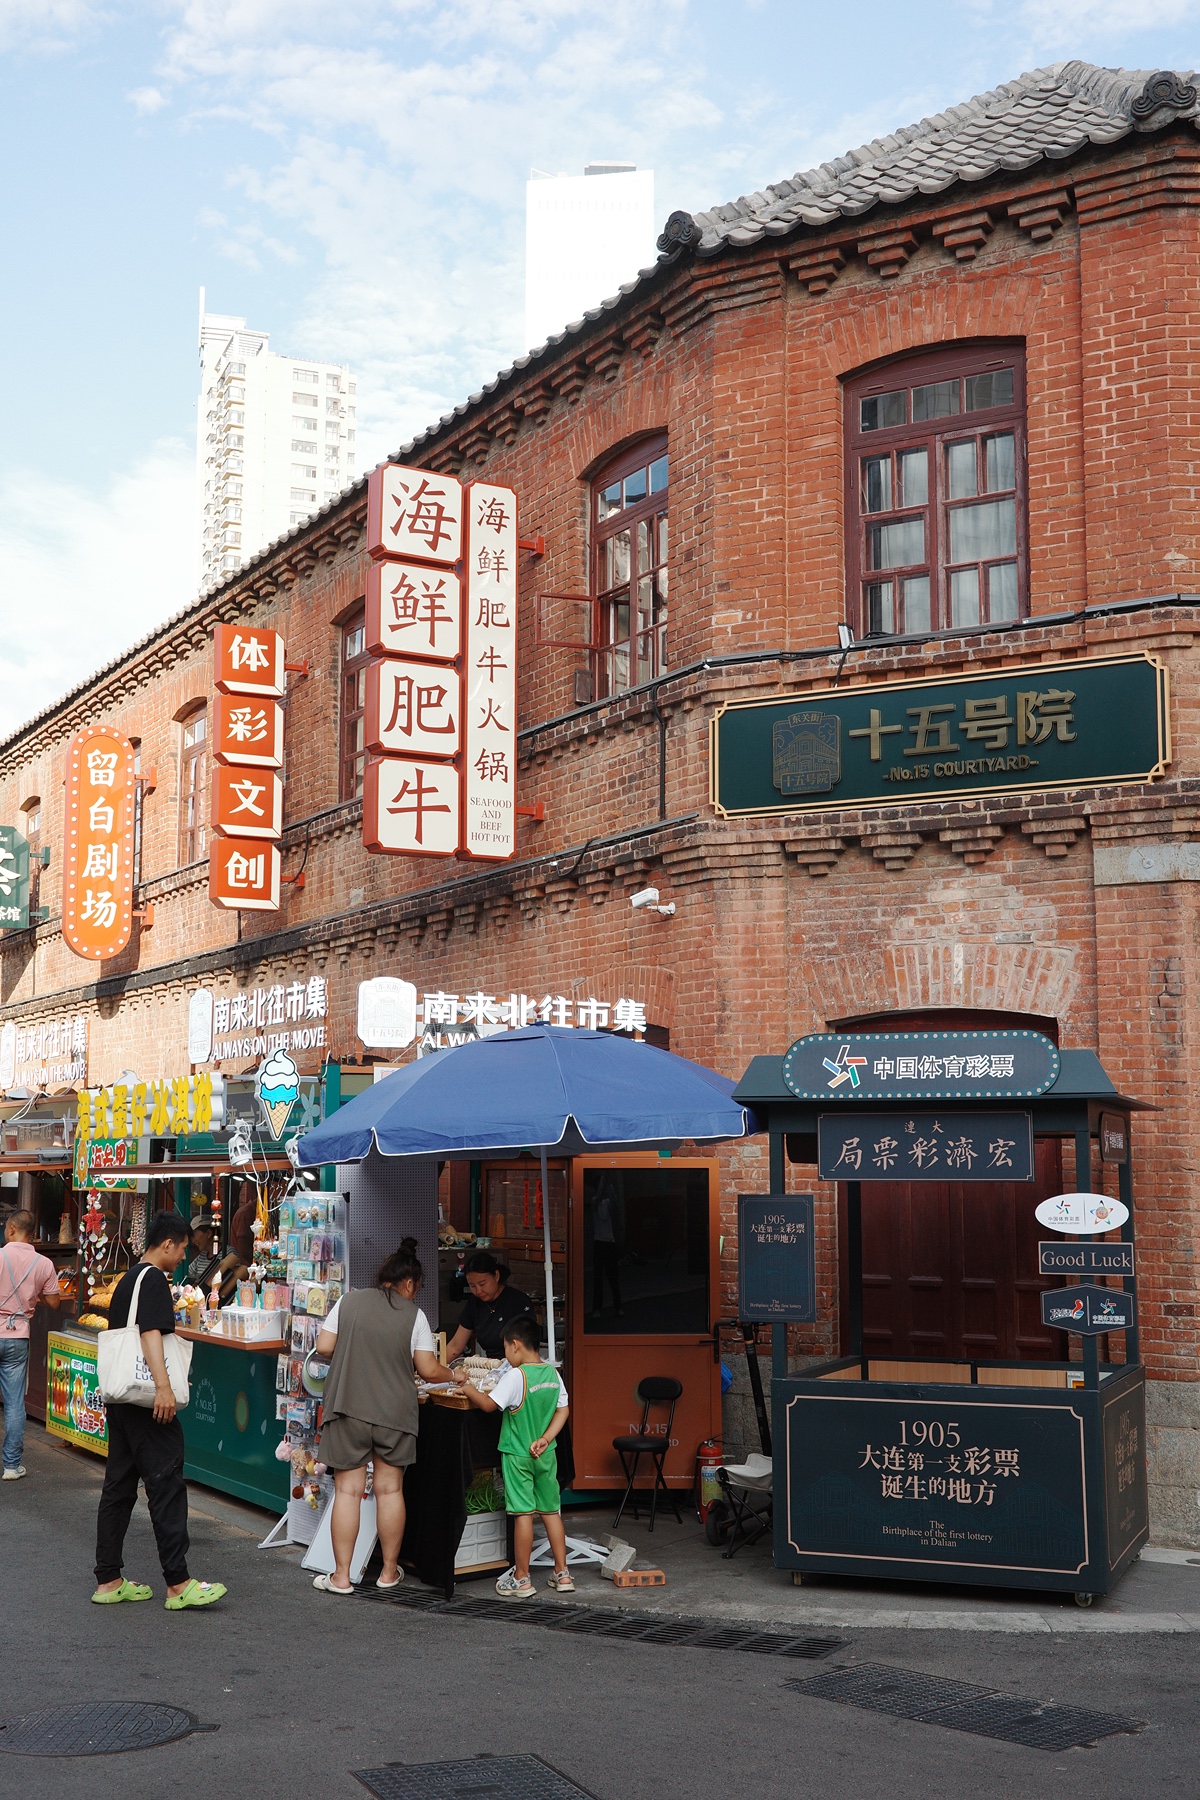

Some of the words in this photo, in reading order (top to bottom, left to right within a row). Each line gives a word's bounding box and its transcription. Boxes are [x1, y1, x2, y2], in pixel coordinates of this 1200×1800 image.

[473, 497, 511, 784] 海鲜肥牛火锅
[383, 478, 457, 846] 海鲜肥牛
[848, 688, 1077, 761] 十五号院
[224, 634, 269, 890] 体彩文创
[784, 772, 829, 788] 十五号院
[470, 797, 512, 808] SEAFOOD
[481, 809, 501, 819] AND
[80, 749, 119, 928] 留白剧场
[471, 832, 490, 842] HOT
[492, 834, 511, 844] POT
[480, 821, 502, 831] BEEF
[213, 976, 327, 1034] 南来北往市集
[423, 991, 647, 1033] 南来北往市集
[16, 1014, 88, 1064] 南来北往市集
[212, 1038, 250, 1061] ALWAYS
[250, 1036, 267, 1056] ON
[291, 1027, 326, 1050] MOVE
[14, 1069, 39, 1087] ALWAYS
[50, 1063, 65, 1083] THE
[65, 1058, 87, 1081] MOVE
[873, 1055, 1015, 1080] 中国体育彩票
[749, 1222, 806, 1234] 大连第一支彩票
[763, 1214, 786, 1225] 1905
[757, 1233, 798, 1244] 诞生的地方
[1041, 1251, 1085, 1267] Good
[1090, 1252, 1131, 1268] Luck
[899, 1420, 961, 1448] 1905
[858, 1444, 1020, 1477] 大连第一支彩票
[880, 1473, 997, 1506] 诞生的地方
[882, 1526, 922, 1537] Birthplace
[924, 1528, 935, 1537] of
[935, 1529, 947, 1539] the
[949, 1530, 965, 1540] first
[967, 1532, 993, 1543] lottery
[929, 1520, 945, 1530] The
[921, 1537, 928, 1545] in
[930, 1537, 957, 1547] Dalian
